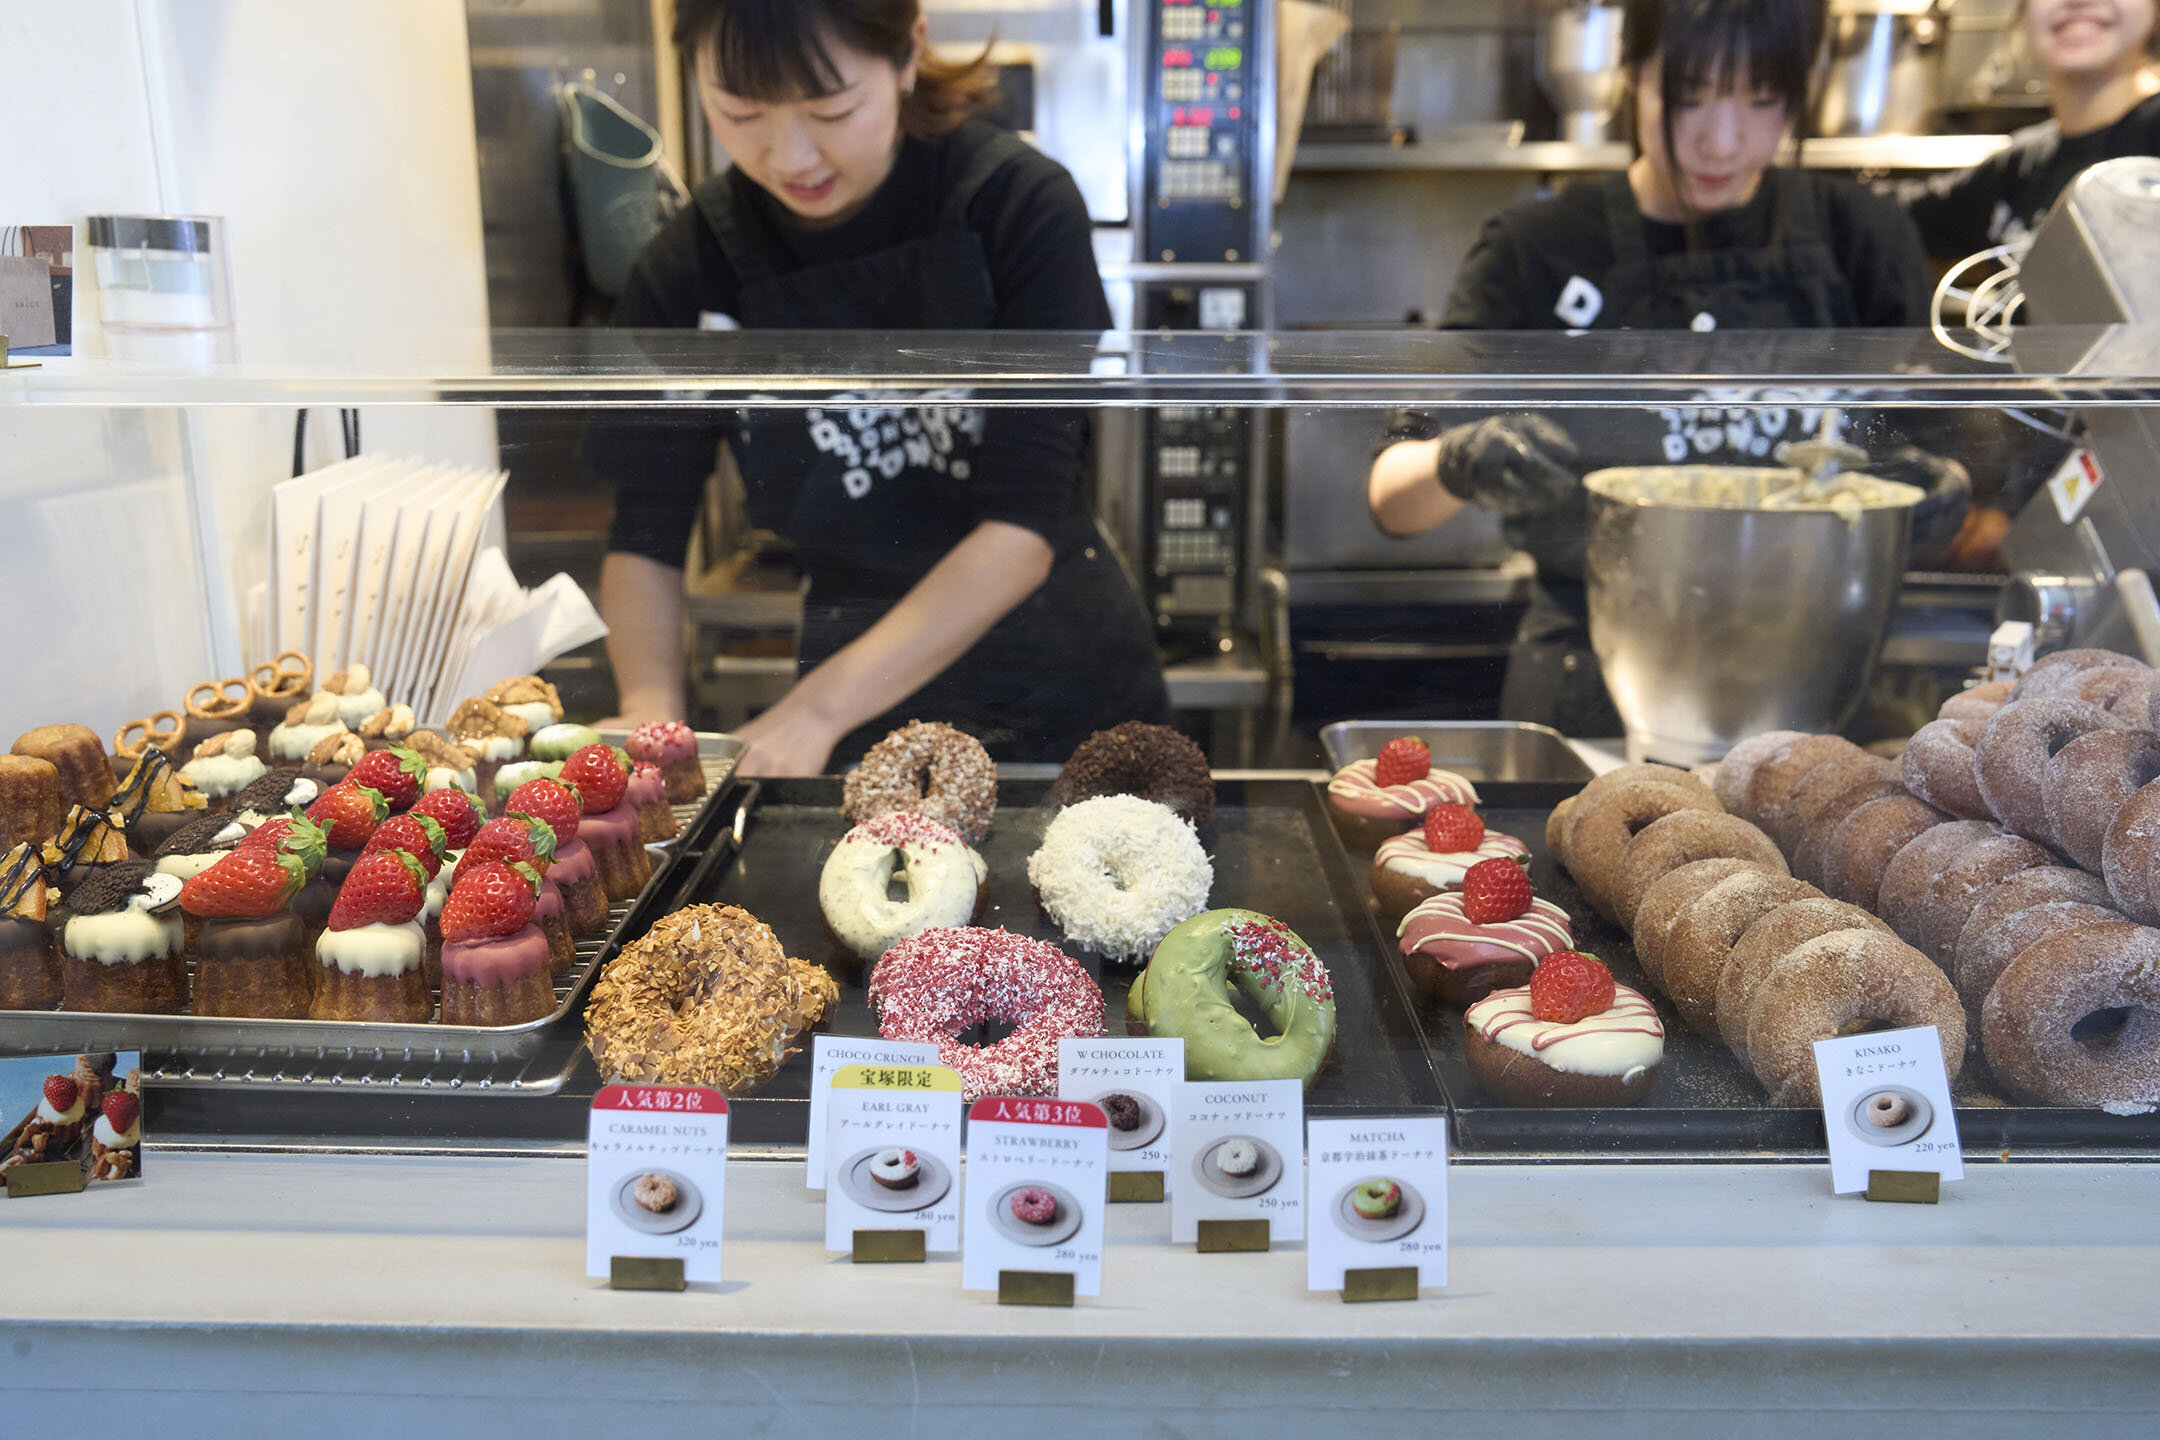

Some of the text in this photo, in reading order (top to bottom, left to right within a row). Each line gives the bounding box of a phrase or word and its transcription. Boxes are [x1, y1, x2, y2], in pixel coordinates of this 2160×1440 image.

[827, 1049, 926, 1064] CHOCO CRUNCH
[1077, 1049, 1165, 1060] W CHOCOLATE
[1854, 1043, 1901, 1059] KINAKO
[1069, 1066, 1174, 1077] ダブルチョコドーナツ
[1845, 1059, 1917, 1077] きなこドーナツ
[859, 1068, 933, 1089] 宝塚限定
[617, 1089, 703, 1110] 人気第2位
[1205, 1093, 1268, 1104] COCONUT
[862, 1101, 930, 1114] EARL GRAY
[994, 1101, 1083, 1124] 人気第3位
[1188, 1111, 1287, 1122] ココナッツドーナツ
[609, 1123, 707, 1137] CARAMEL NUTS
[839, 1119, 951, 1132] アールグレイドーナツ
[994, 1135, 1080, 1150] STRAWBERRY
[1350, 1132, 1405, 1143] MATCHA
[590, 1141, 725, 1156] キャラメルナッツドーナツ
[1915, 1141, 1955, 1154] 220 yen
[979, 1153, 1095, 1169] ストロベリードーナツ
[1141, 1150, 1160, 1161] 250
[1320, 1150, 1434, 1163] 京都宇治抹茶ドーナツ
[1258, 1198, 1298, 1210] 250 yen
[914, 1210, 955, 1224] 280 yen
[676, 1236, 719, 1250] 320 yen
[1399, 1242, 1442, 1254] 280 yen
[1055, 1248, 1098, 1262] 280 yen
